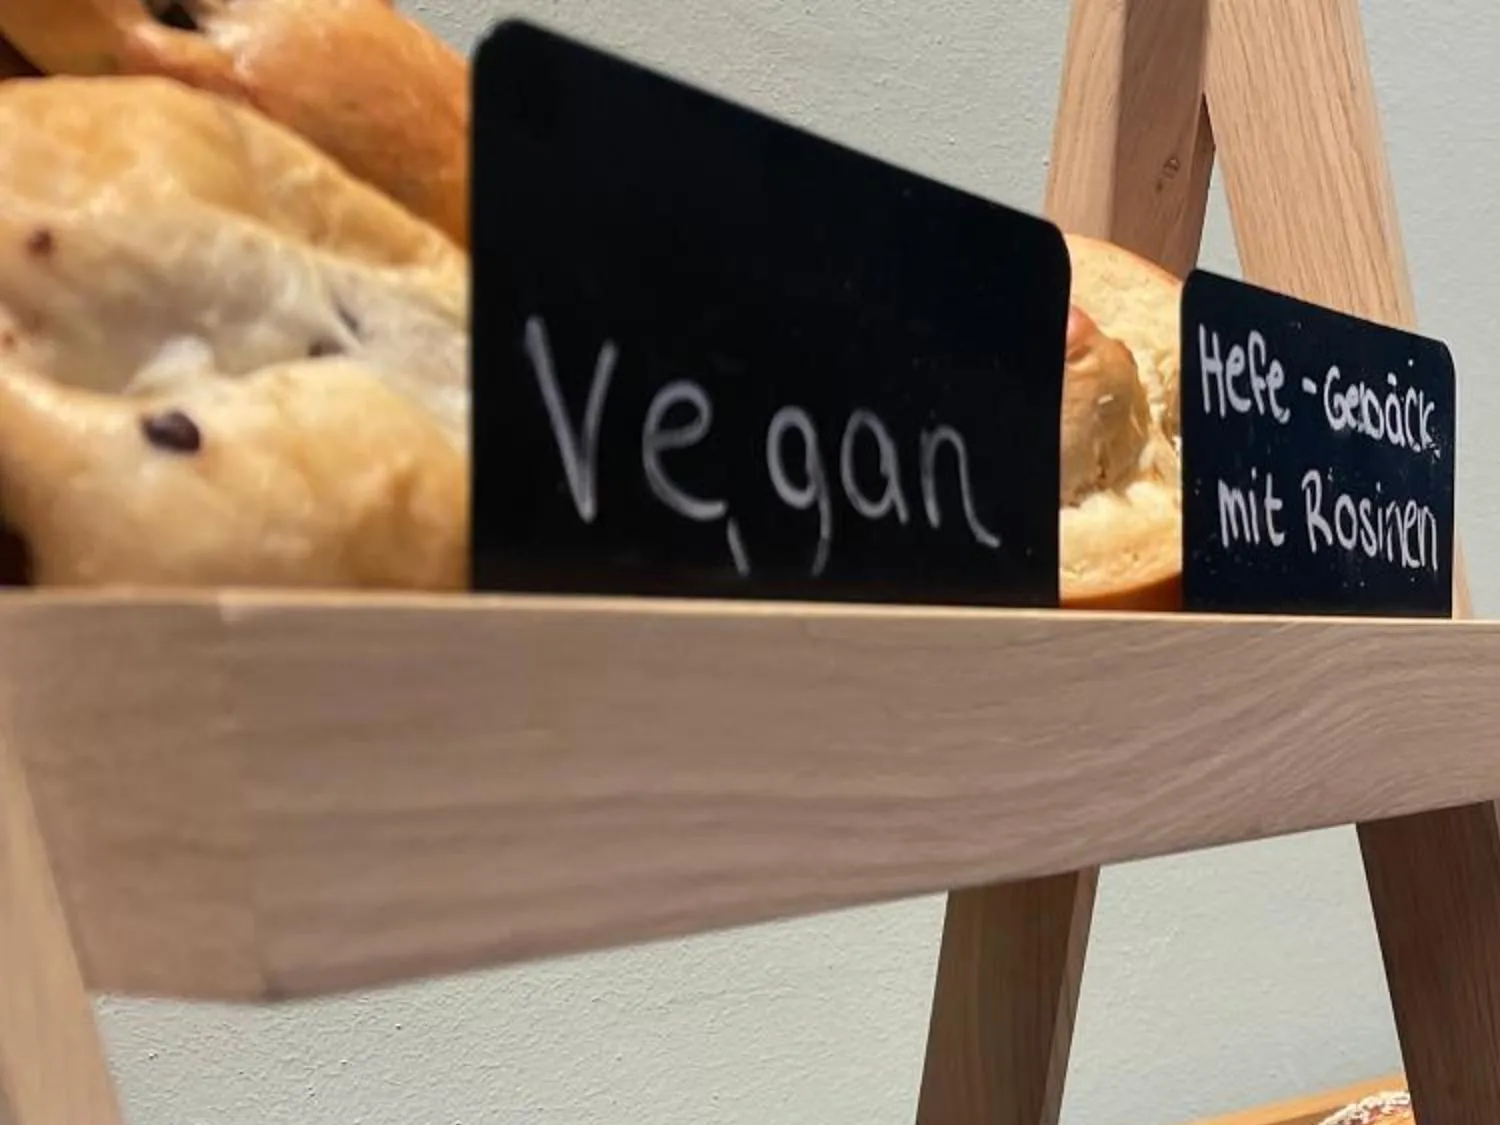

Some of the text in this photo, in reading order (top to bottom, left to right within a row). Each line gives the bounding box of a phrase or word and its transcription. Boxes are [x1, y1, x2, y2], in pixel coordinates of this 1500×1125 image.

[524, 315, 1000, 577] Vegan
[1217, 466, 1439, 571] mit Rosinen
